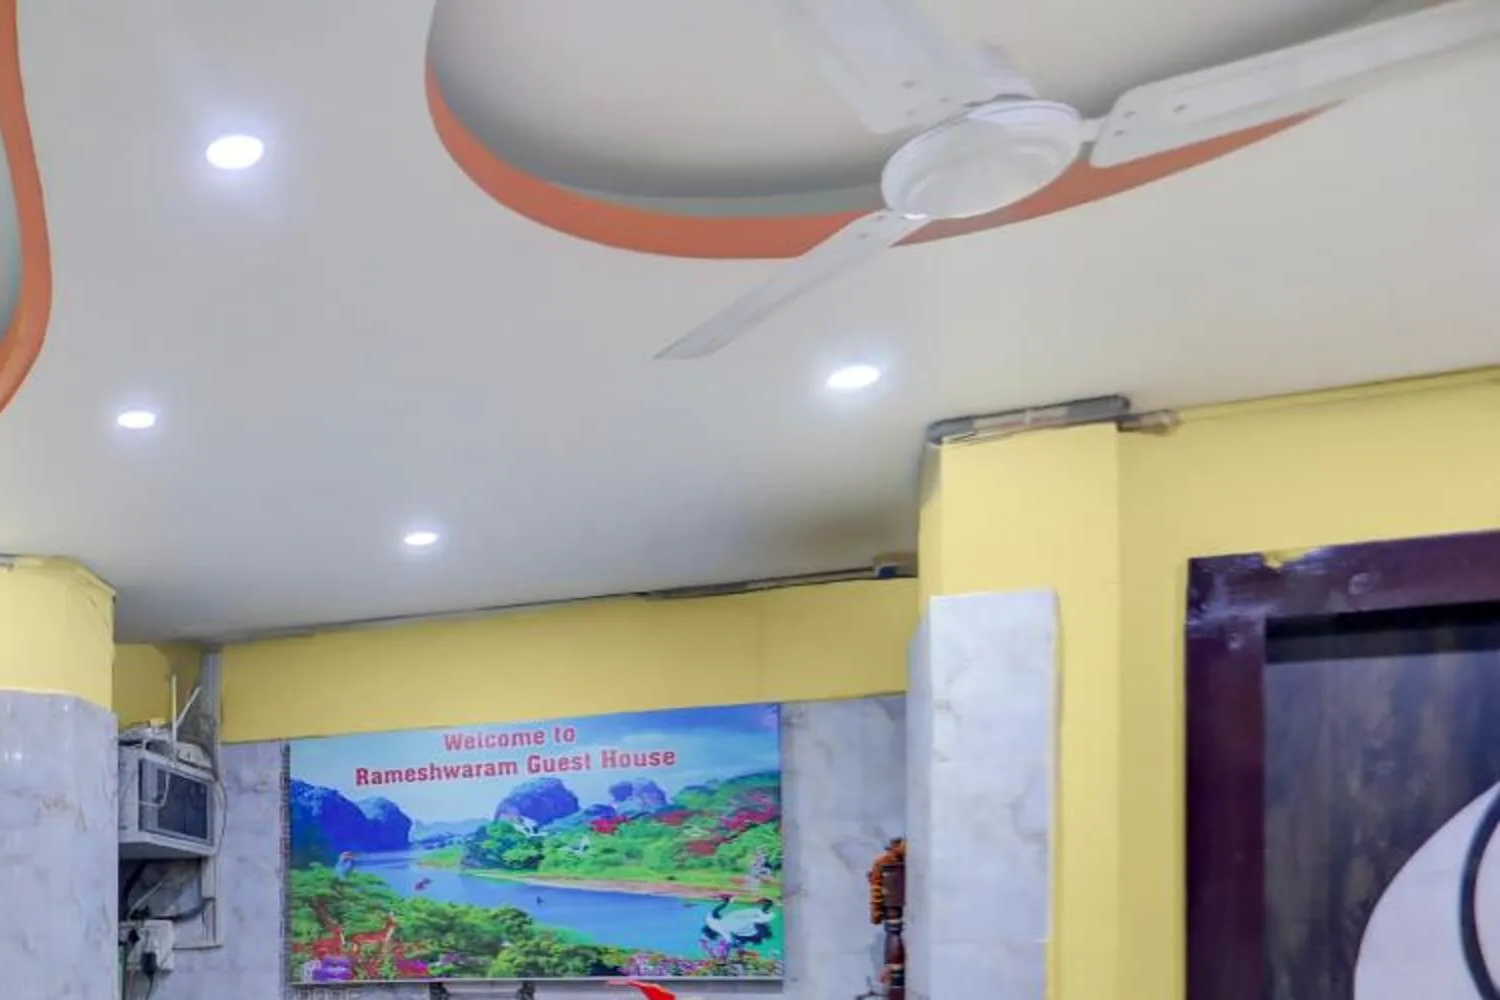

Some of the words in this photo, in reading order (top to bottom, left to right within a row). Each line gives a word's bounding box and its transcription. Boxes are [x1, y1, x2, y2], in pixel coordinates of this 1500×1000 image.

[444, 729, 545, 751] Welcome
[553, 726, 576, 743] to
[355, 760, 518, 786] Rameshwaram
[526, 754, 591, 774] Guest
[601, 749, 676, 769] House
